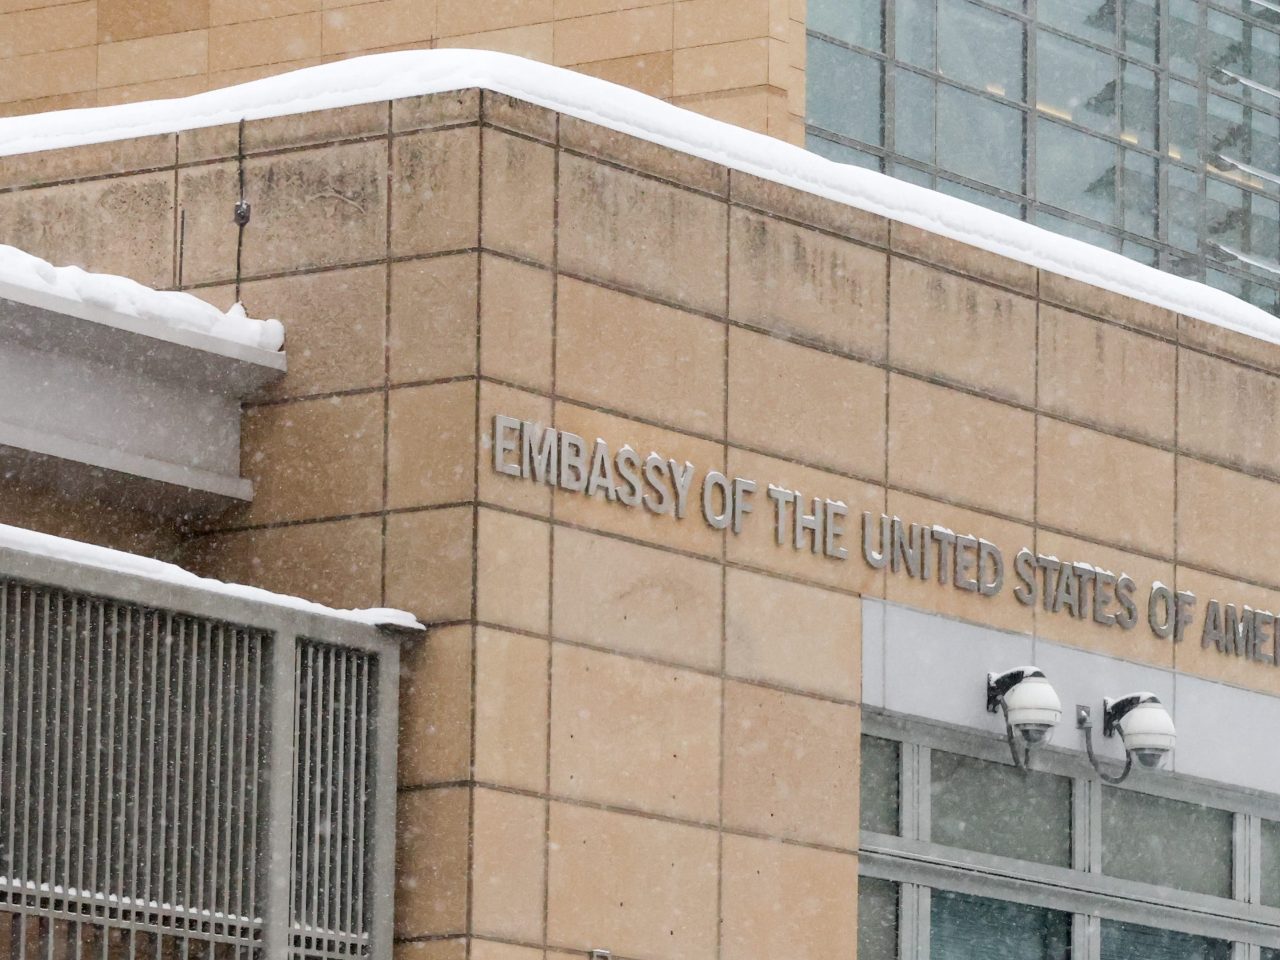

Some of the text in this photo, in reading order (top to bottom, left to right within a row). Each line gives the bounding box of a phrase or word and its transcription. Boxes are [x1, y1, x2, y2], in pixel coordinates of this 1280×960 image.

[494, 414, 694, 518] EMBASSY
[700, 470, 757, 534] OF
[768, 483, 849, 560] THE
[861, 511, 1004, 596] UNITED
[1013, 546, 1138, 631] STATES
[1147, 580, 1197, 642] OF
